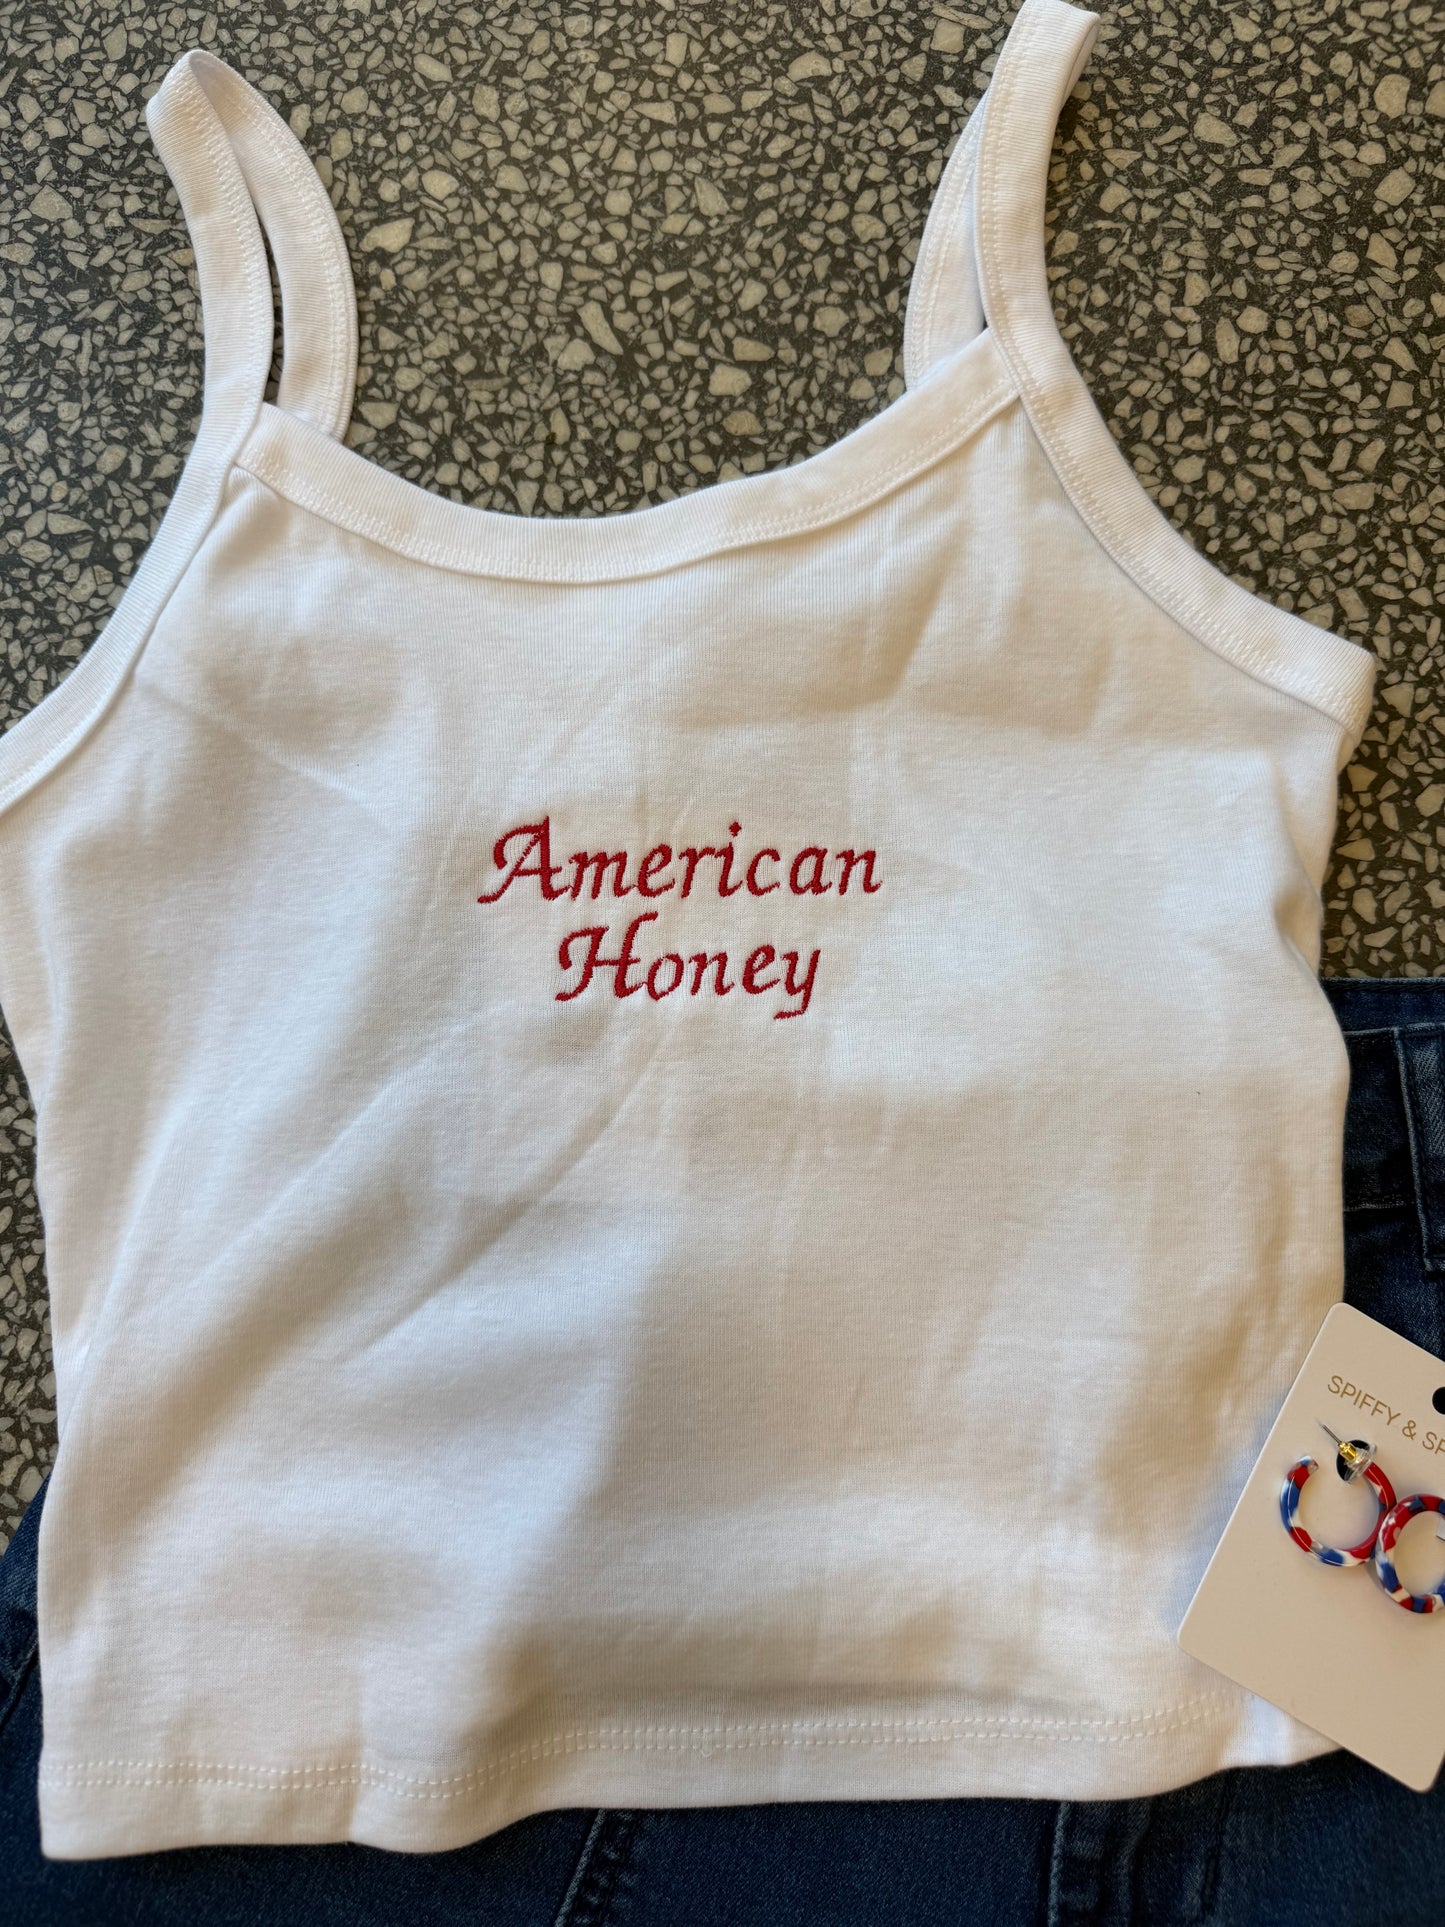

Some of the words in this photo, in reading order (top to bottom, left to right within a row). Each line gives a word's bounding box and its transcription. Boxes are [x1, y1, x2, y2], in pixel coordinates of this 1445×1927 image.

[477, 816, 884, 904] American
[555, 911, 821, 1020] Honey
[1327, 1375, 1401, 1426] SPIFFY
[1402, 1419, 1417, 1441] &
